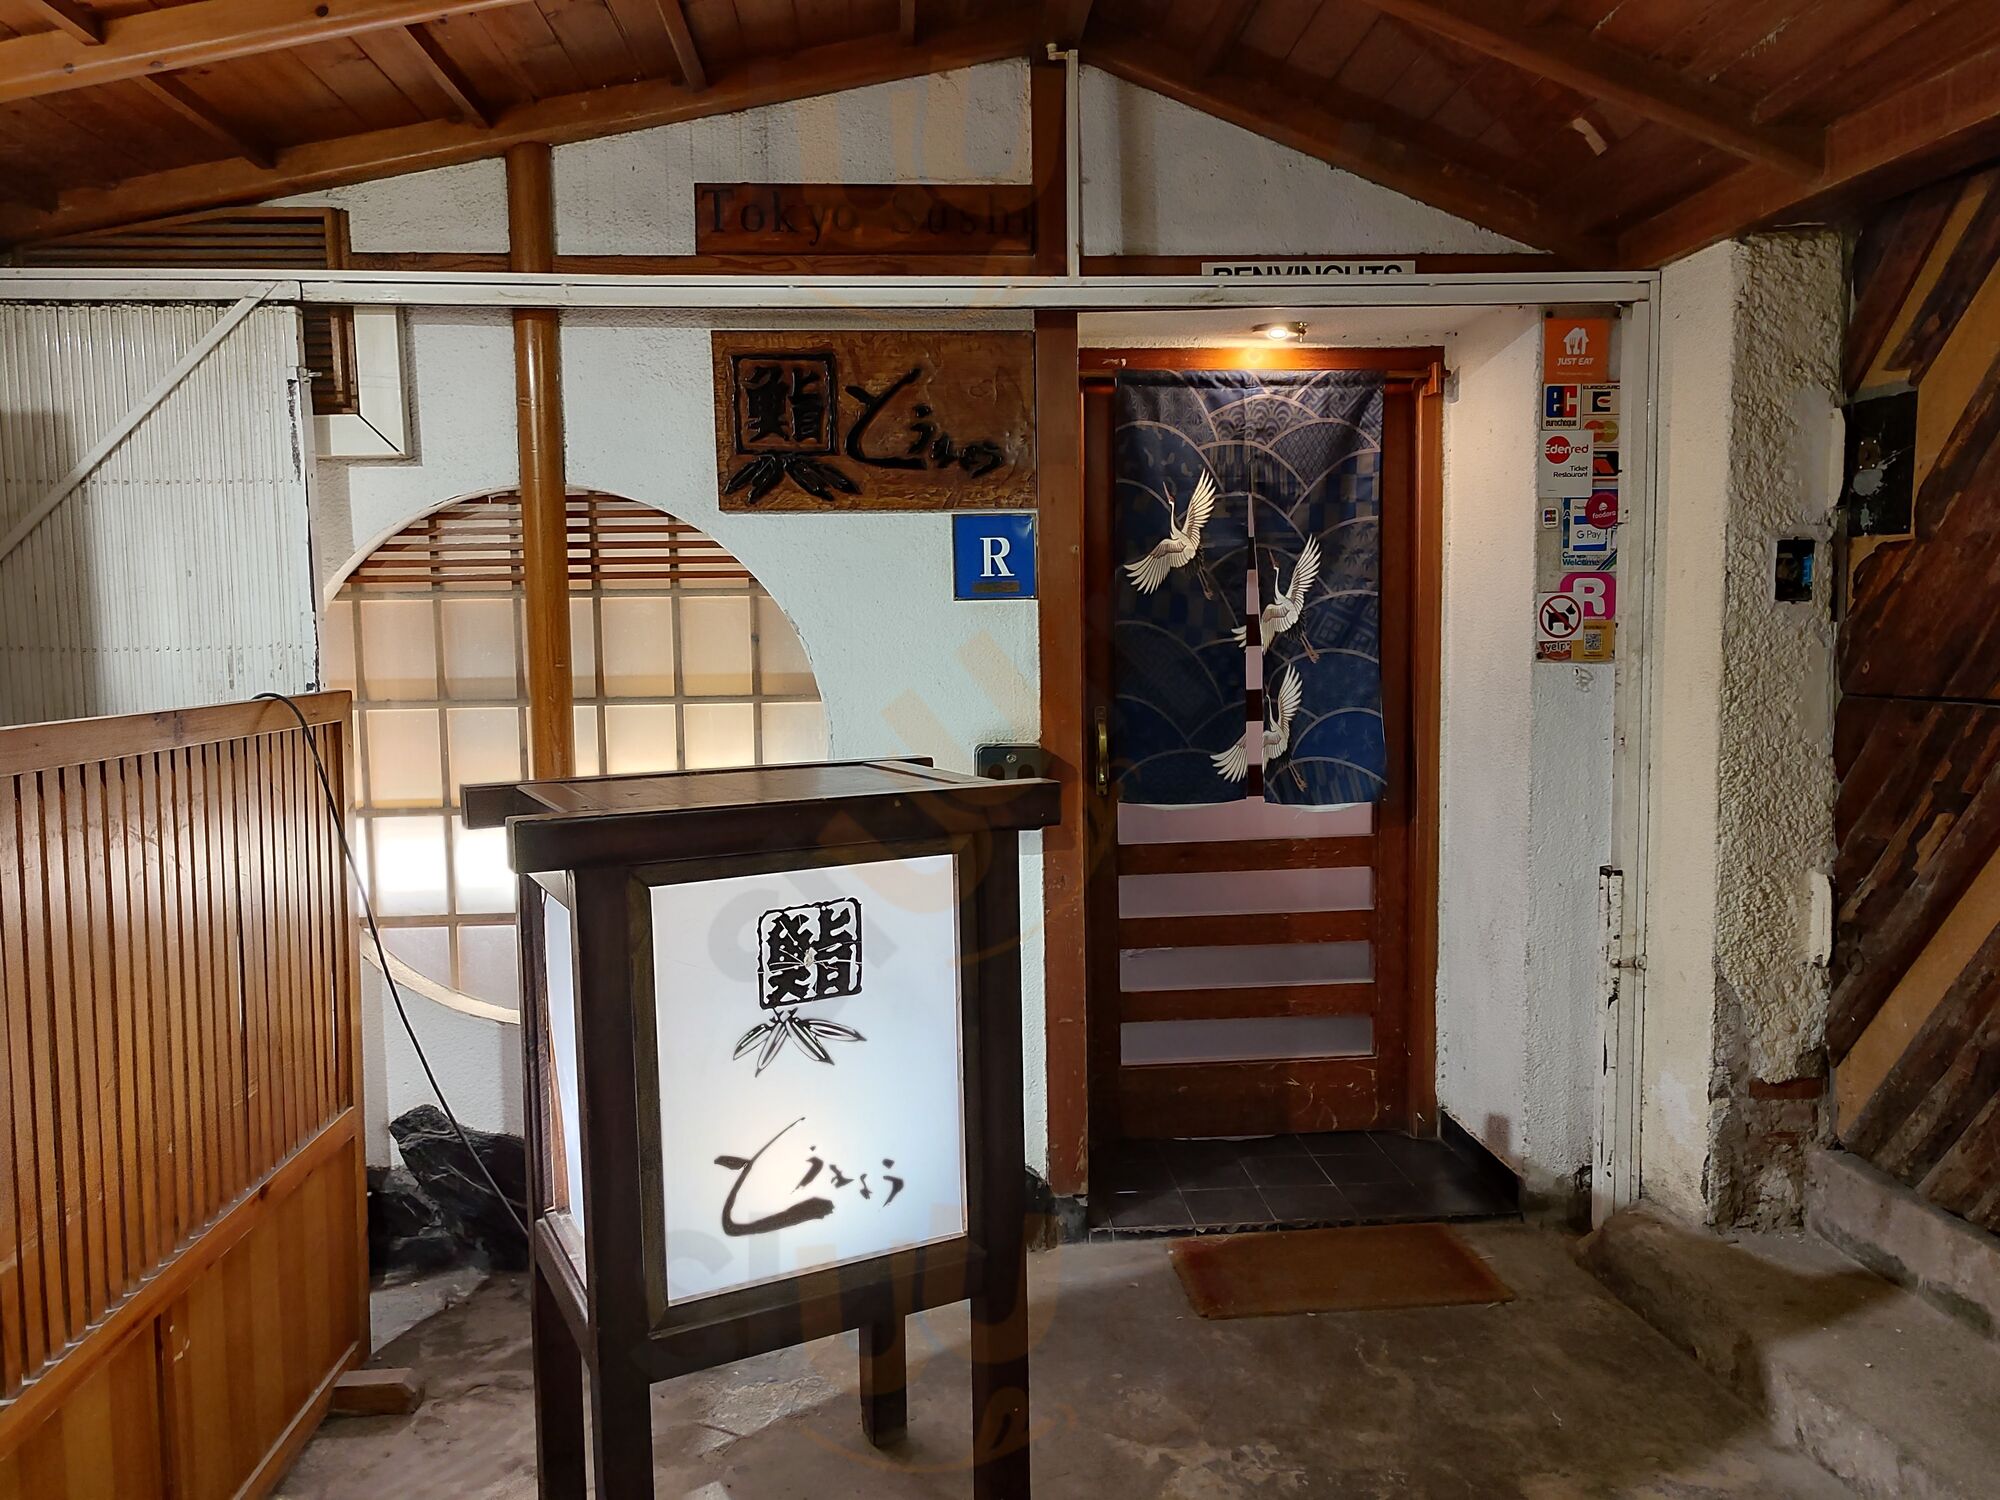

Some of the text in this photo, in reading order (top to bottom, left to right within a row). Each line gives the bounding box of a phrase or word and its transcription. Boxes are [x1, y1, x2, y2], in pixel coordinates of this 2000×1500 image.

[702, 188, 857, 247] Tokyo
[1557, 357, 1593, 366] JUST EAT
[1545, 444, 1588, 454] Edenred
[1592, 510, 1616, 519] foodora
[1586, 530, 1601, 540] Pay
[980, 537, 1015, 577] R
[1545, 642, 1567, 653] yelp
